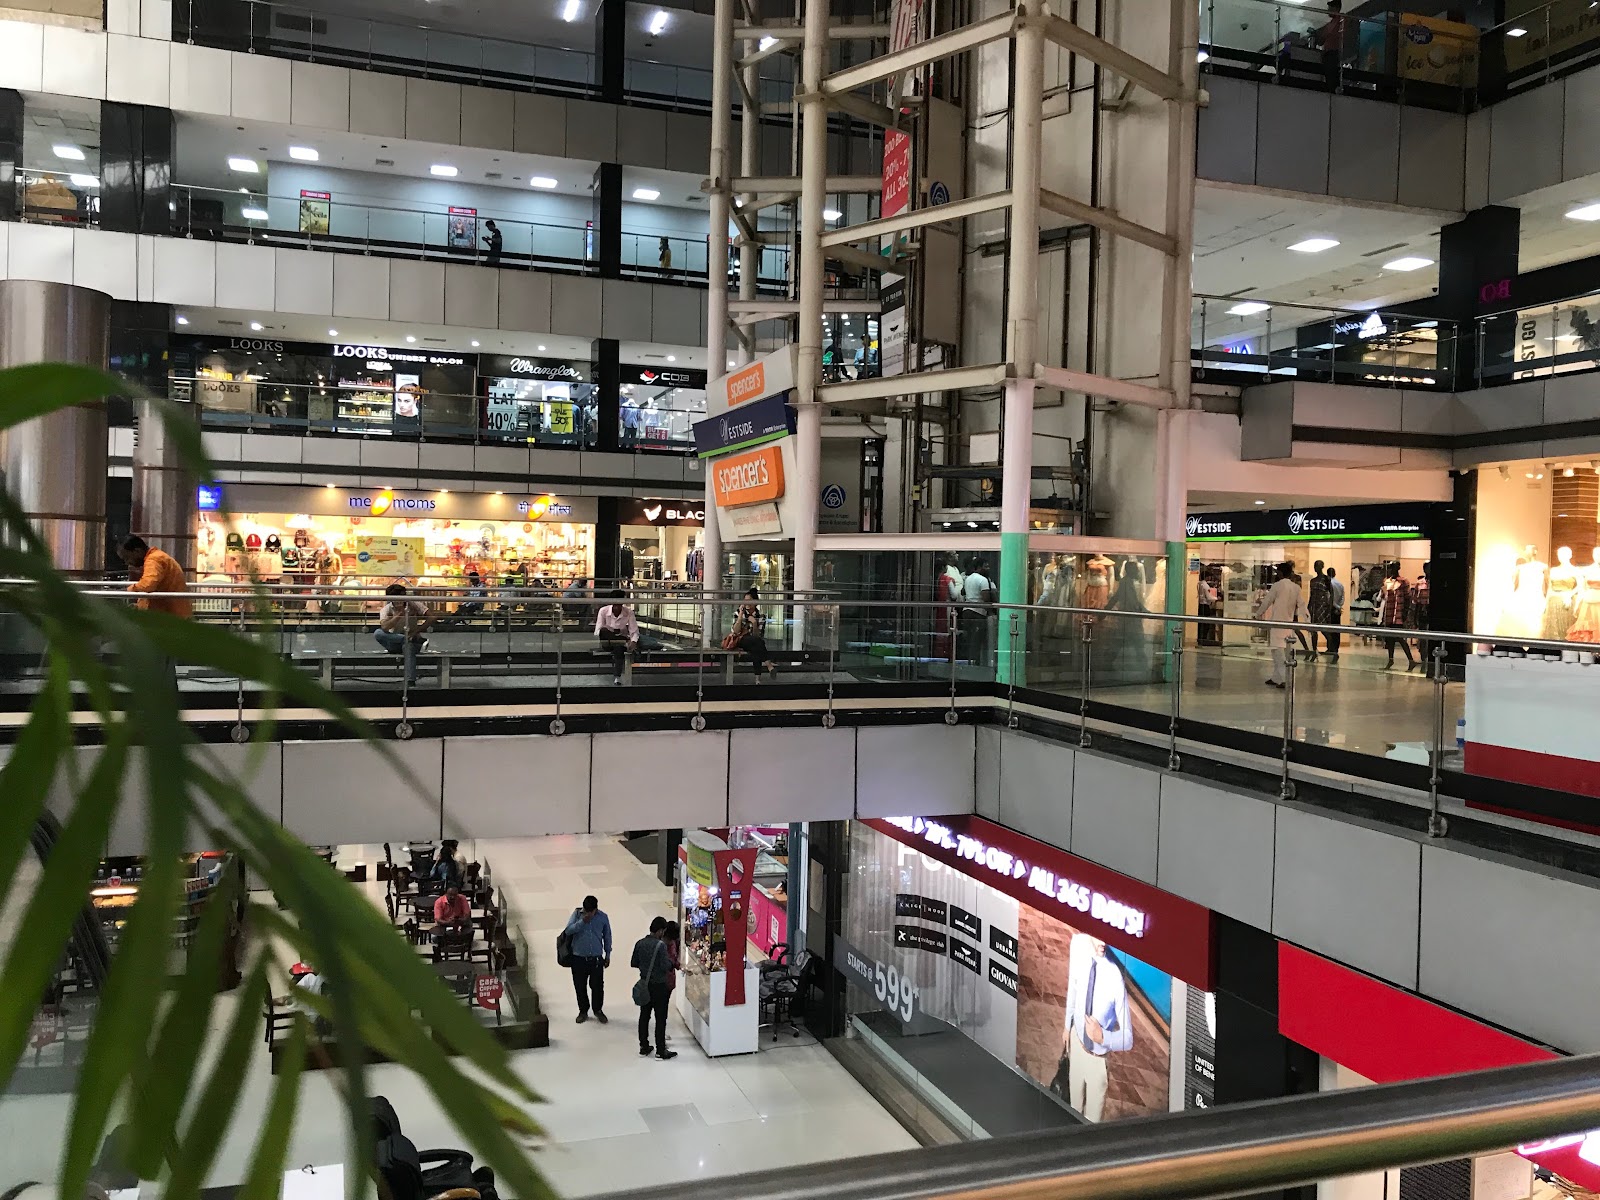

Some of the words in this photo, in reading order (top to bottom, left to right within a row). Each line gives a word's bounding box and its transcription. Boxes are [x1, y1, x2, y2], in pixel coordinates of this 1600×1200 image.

[885, 181, 897, 203] ALL
[230, 338, 284, 352] LOOKS
[333, 345, 388, 360] LOOKS
[388, 353, 427, 363] UNISEX
[429, 356, 464, 365] SALON
[510, 358, 580, 380] Wrangler
[203, 382, 241, 393] LOOKS
[731, 370, 761, 403] spencer's
[488, 411, 515, 431] 40%
[718, 455, 769, 500] spencer's
[349, 497, 372, 507] me
[393, 498, 436, 510] moms
[1186, 516, 1232, 536] WESTSIDE
[1288, 511, 1346, 534] WESTSIDE
[986, 847, 1014, 876] OFF
[1028, 865, 1057, 898] ALL
[1056, 878, 1091, 912] 365
[995, 941, 1017, 959] URBANA
[847, 952, 868, 978] STARTS
[1194, 1054, 1215, 1072] UNITED
[1194, 1063, 1204, 1073] OF
